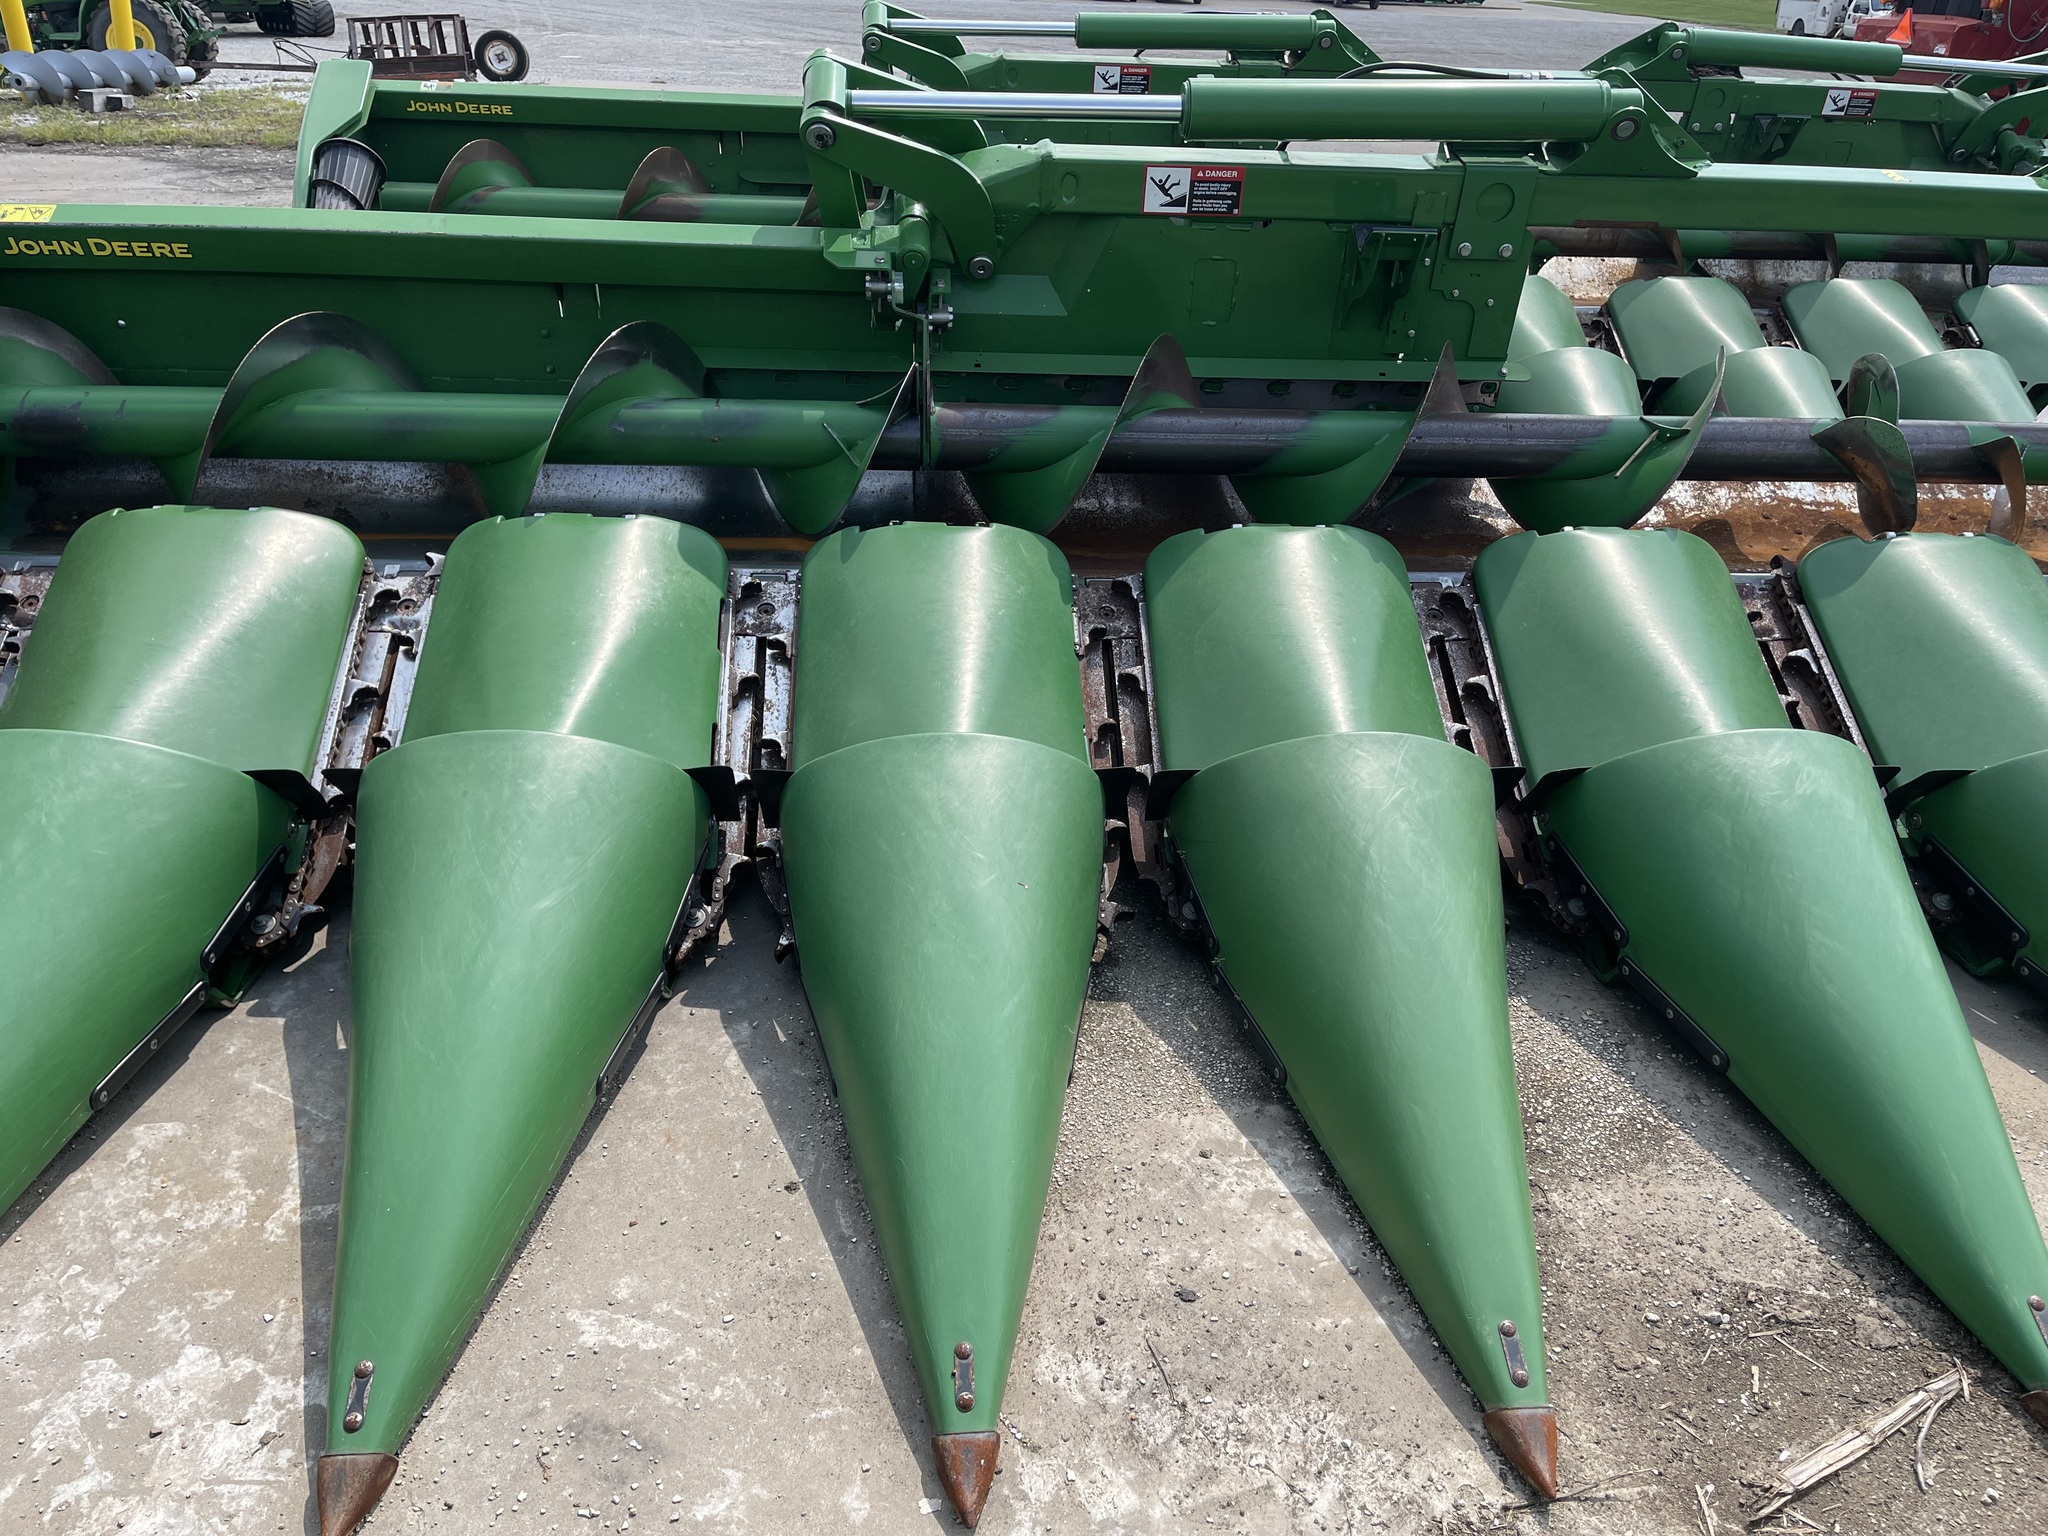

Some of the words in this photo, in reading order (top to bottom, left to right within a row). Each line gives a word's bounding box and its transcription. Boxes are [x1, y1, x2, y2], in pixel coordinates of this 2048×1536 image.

[406, 100, 452, 113] JOHN
[455, 101, 513, 115] DEERE
[4, 236, 85, 256] JOHN
[86, 238, 193, 259] DEERE
